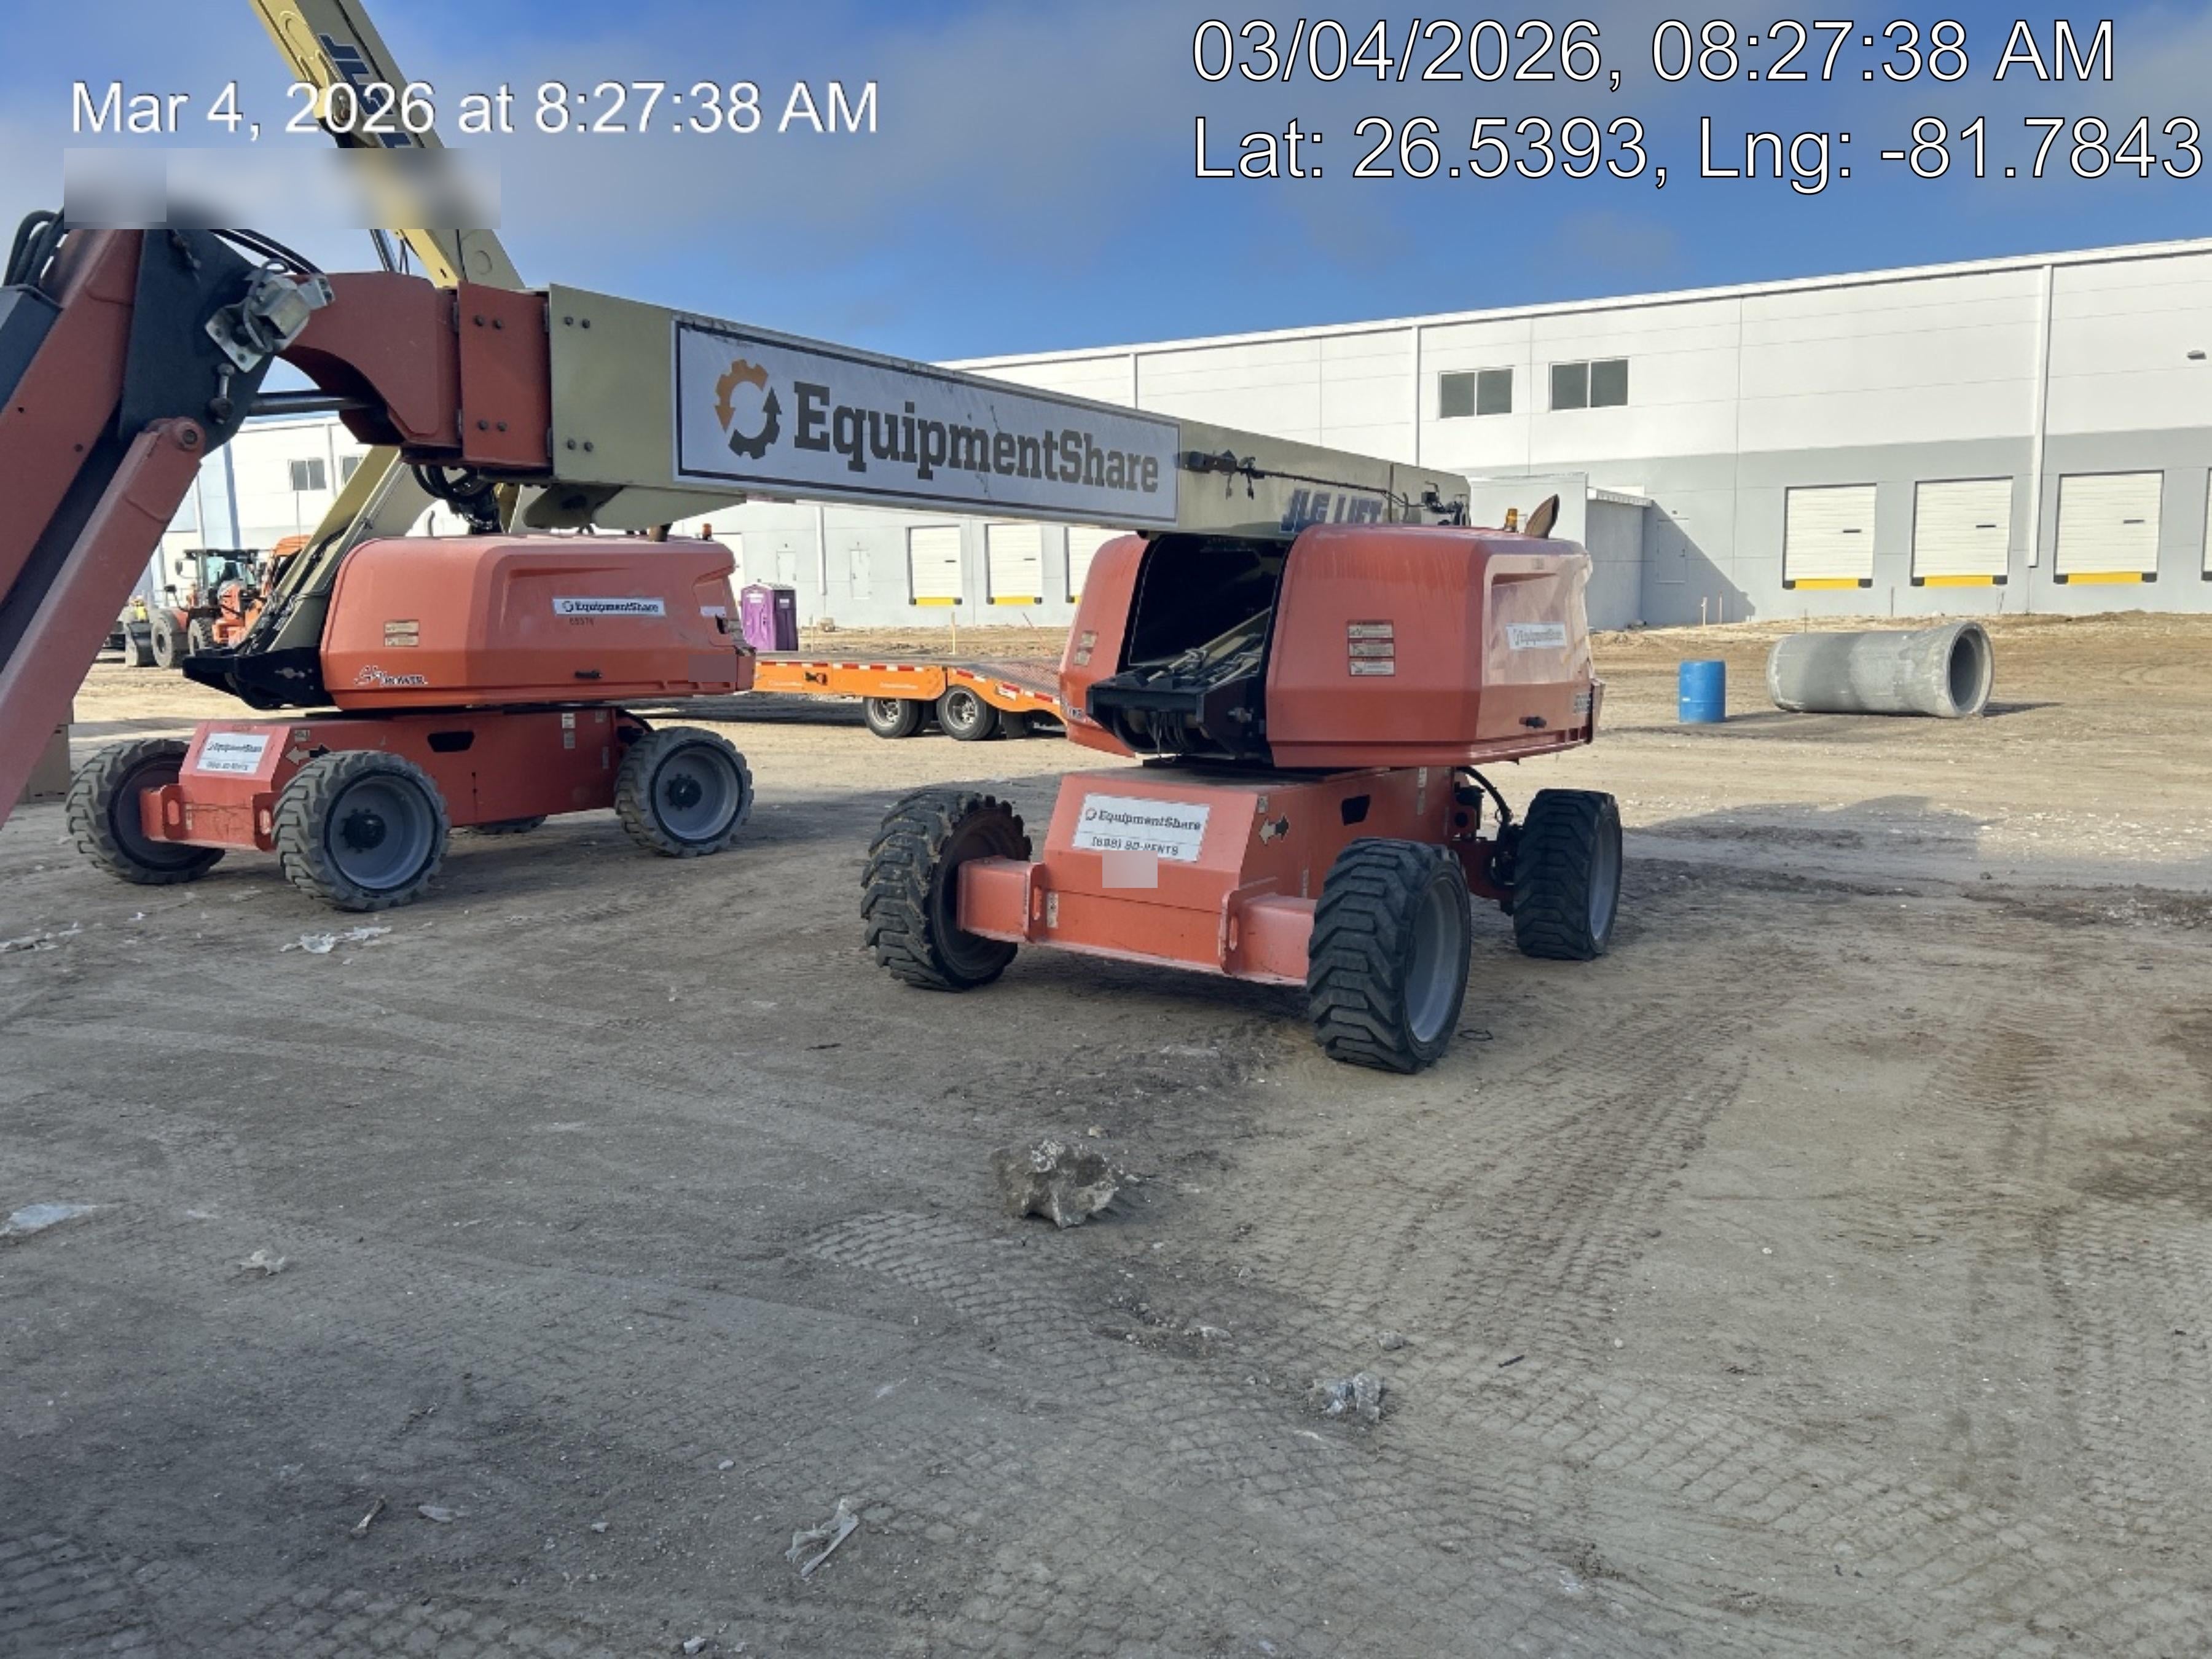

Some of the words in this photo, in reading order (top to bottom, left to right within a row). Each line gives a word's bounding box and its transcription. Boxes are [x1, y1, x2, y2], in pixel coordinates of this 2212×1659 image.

[793, 380, 1159, 493] EquipmentShare
[575, 600, 659, 613] EquipmentShare
[1098, 809, 1201, 831] EquipmentShare
